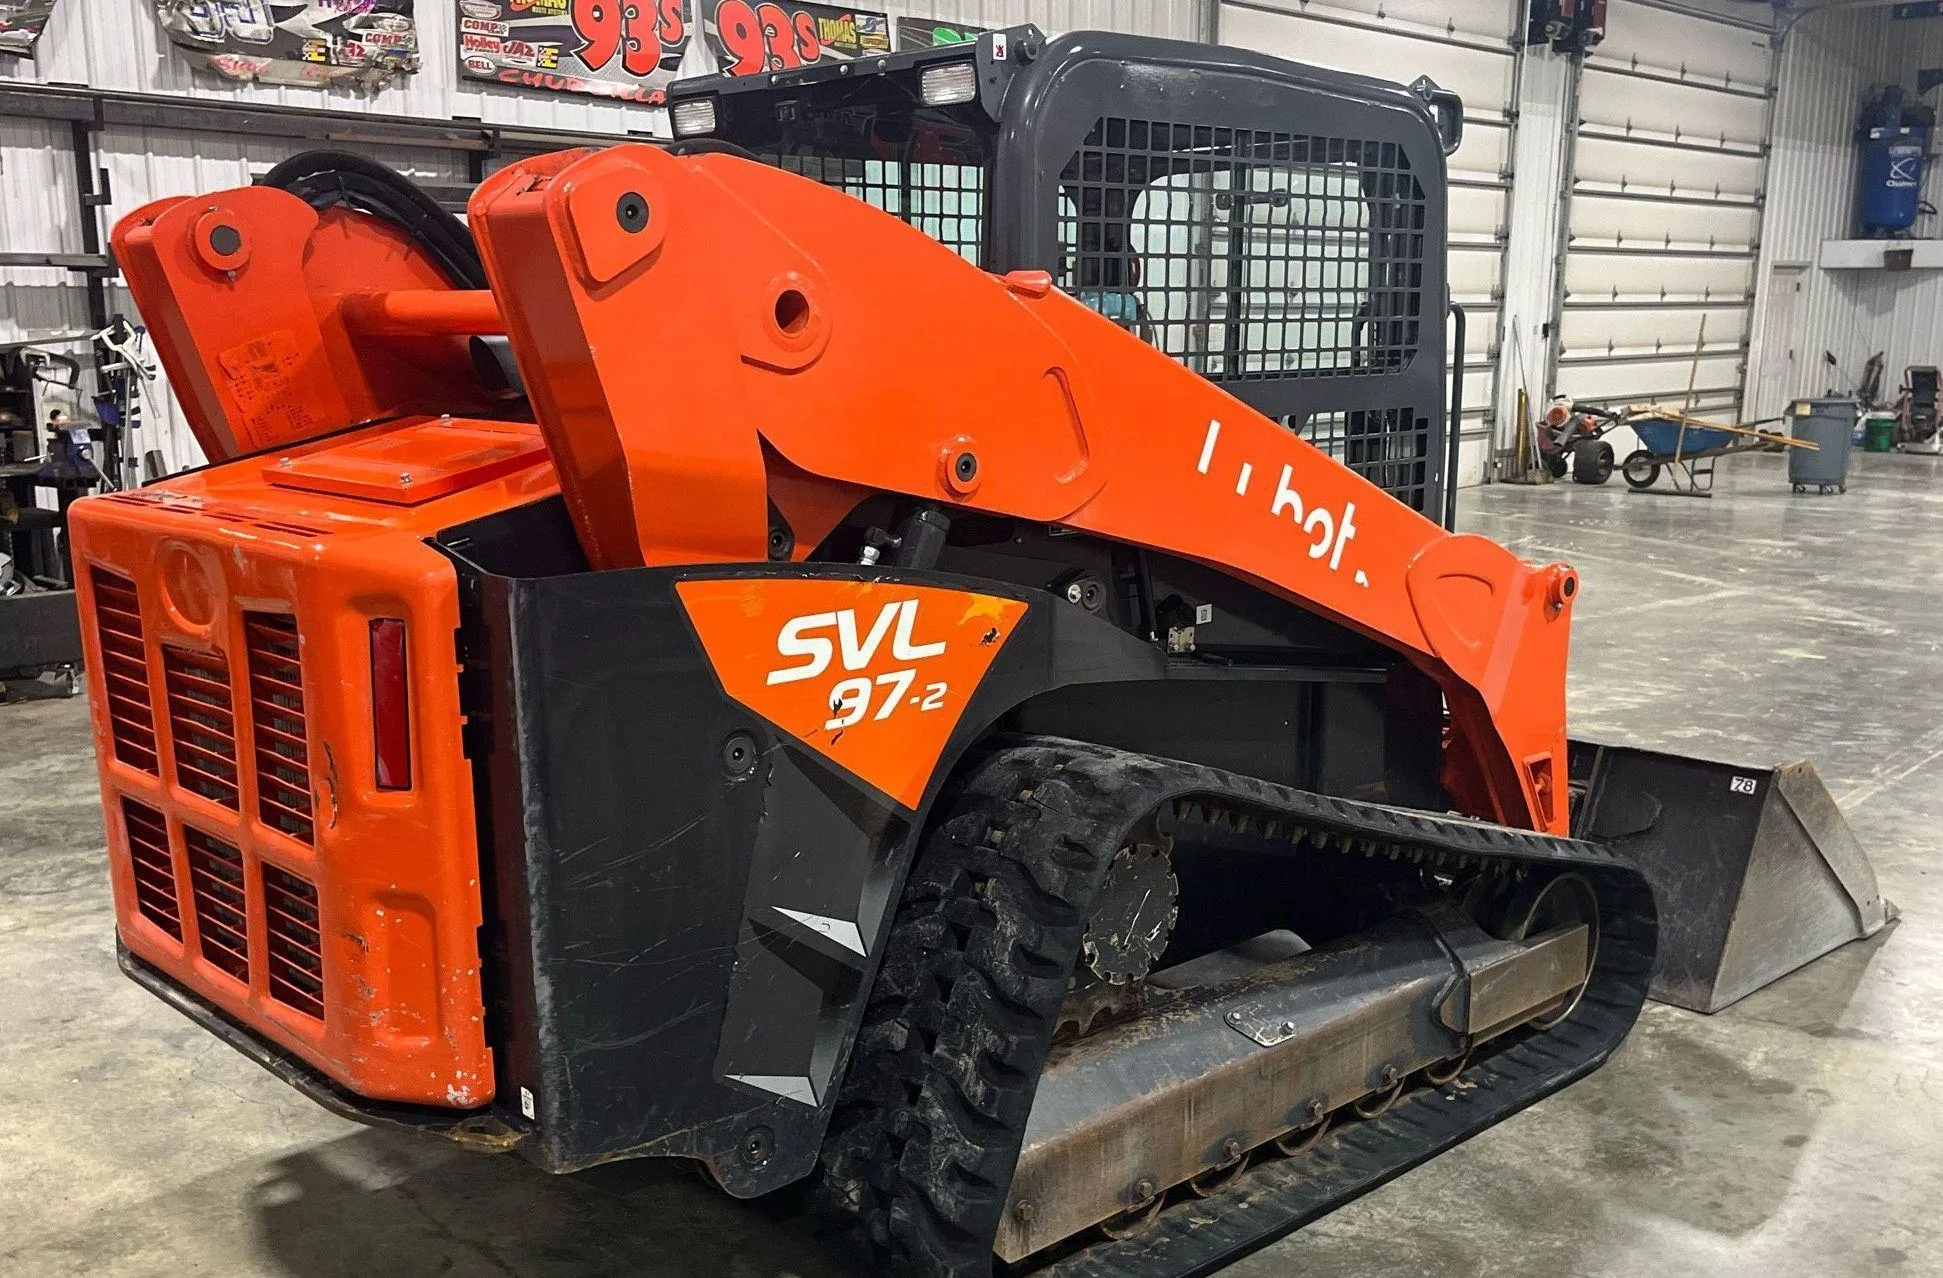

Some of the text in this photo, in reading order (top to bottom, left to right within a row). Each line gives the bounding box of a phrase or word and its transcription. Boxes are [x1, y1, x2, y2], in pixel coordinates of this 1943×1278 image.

[463, 19, 498, 33] COMP
[817, 17, 856, 44] THOMAS
[464, 34, 500, 54] Holley
[467, 59, 493, 70] BELL
[766, 599, 947, 685] SVL
[824, 668, 948, 731] 97-2
[1733, 776, 1754, 793] 78
